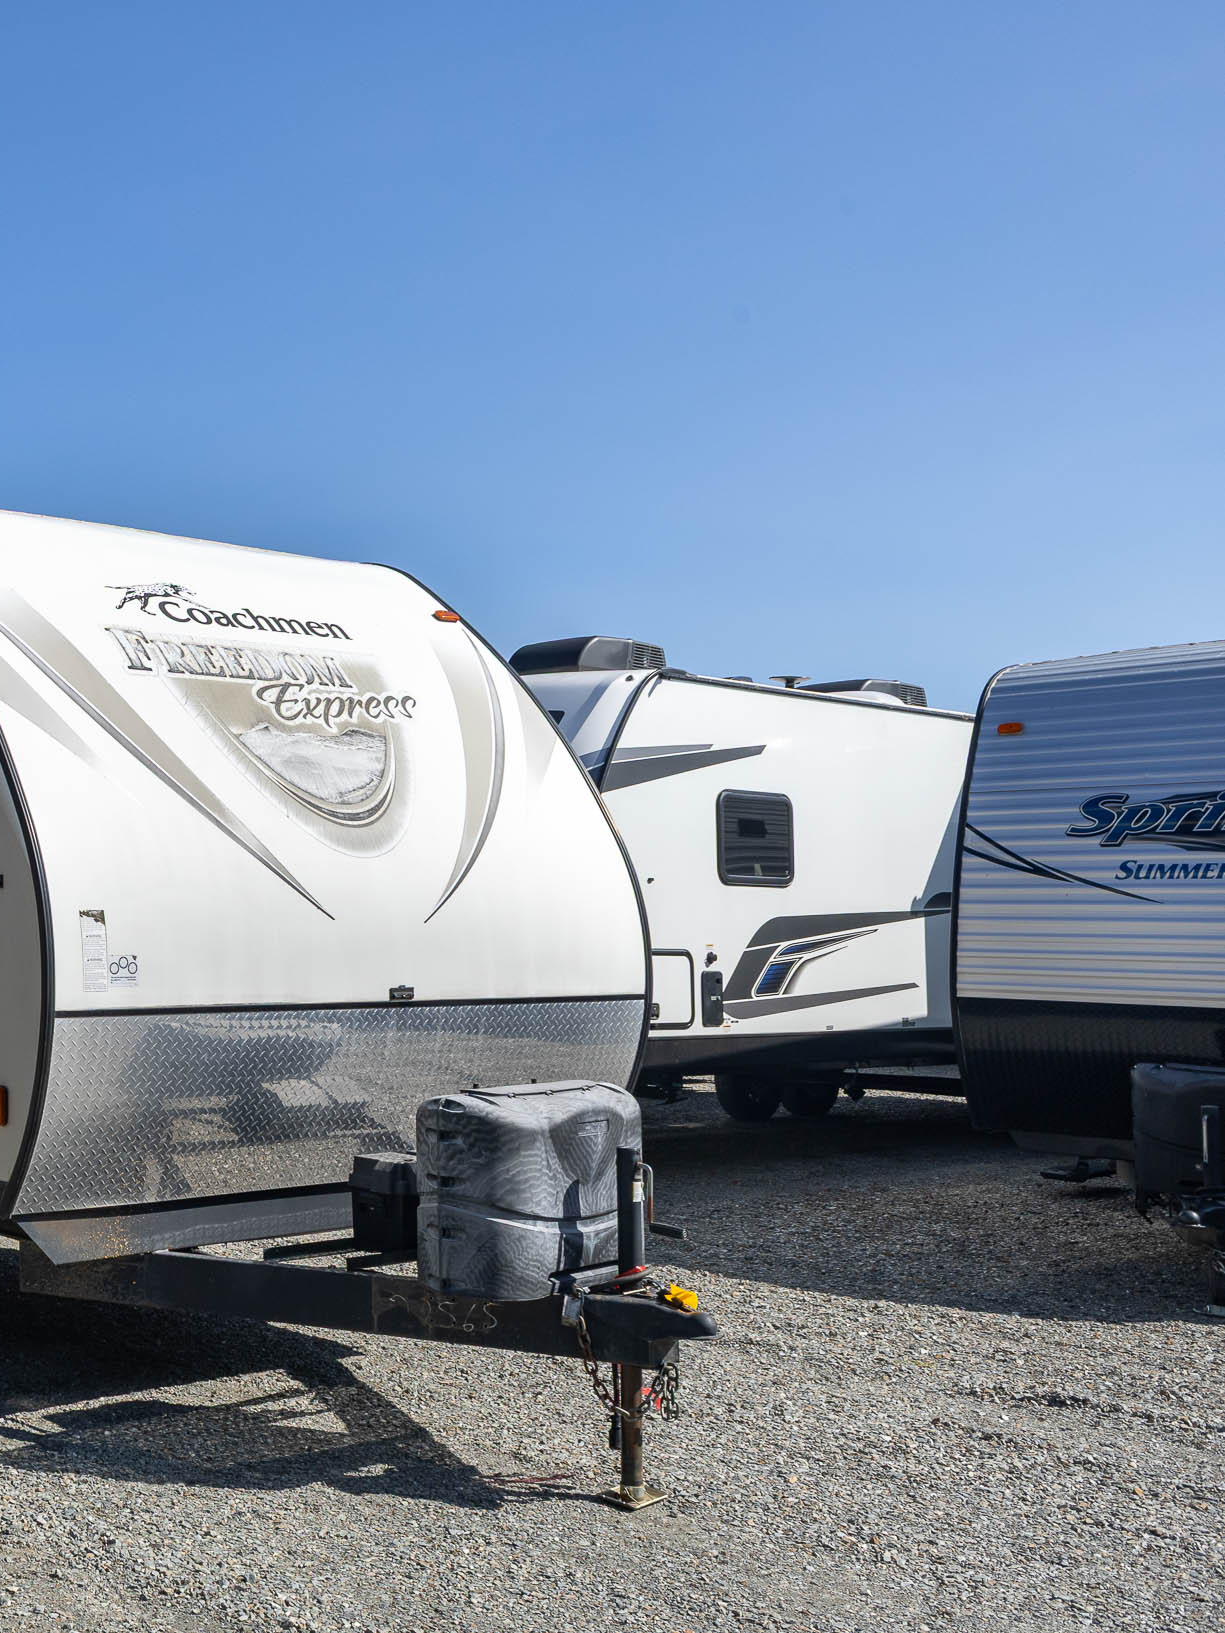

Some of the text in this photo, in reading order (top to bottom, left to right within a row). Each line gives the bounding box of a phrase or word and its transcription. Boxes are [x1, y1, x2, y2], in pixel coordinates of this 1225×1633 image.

[158, 600, 354, 641] Coachmen
[105, 626, 354, 689] FREEDOM
[256, 682, 417, 729] Express
[1065, 792, 1225, 848] Spri
